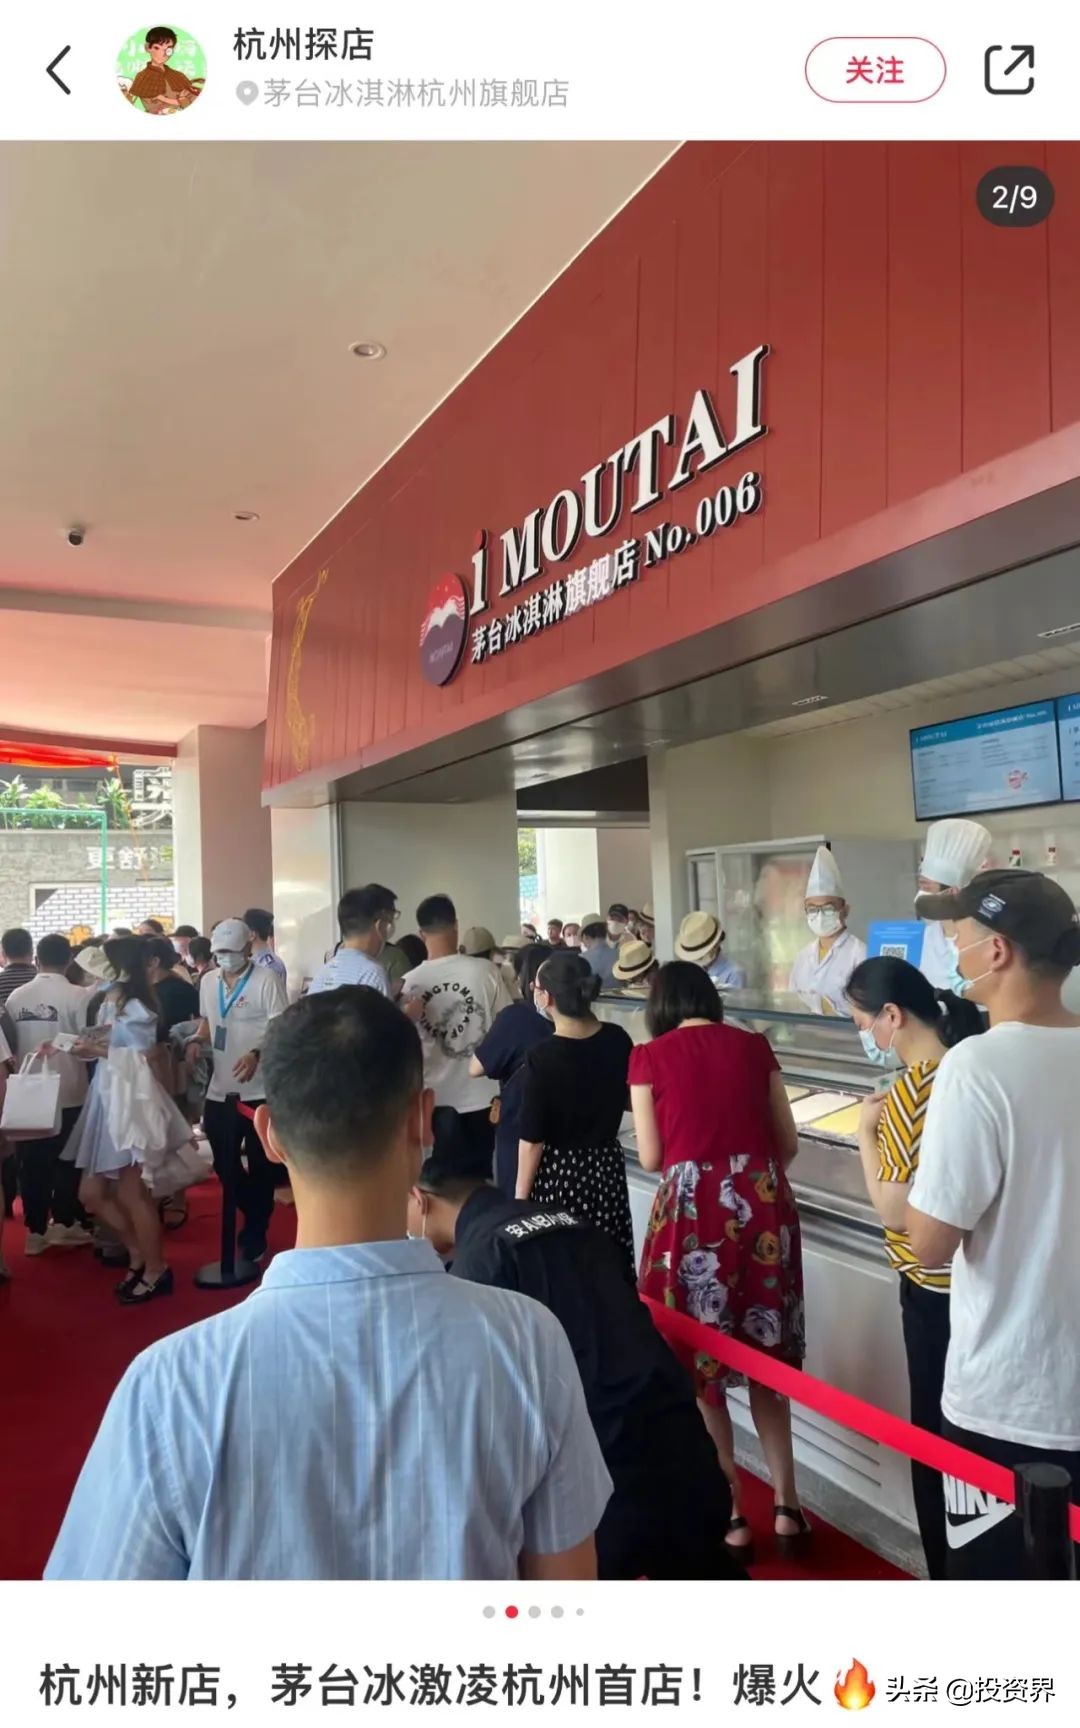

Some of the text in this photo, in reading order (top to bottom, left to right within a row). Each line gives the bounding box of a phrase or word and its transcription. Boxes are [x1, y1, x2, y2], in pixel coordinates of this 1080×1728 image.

[471, 471, 761, 663] 茅台冰淇淋旗舰店 No.006
[499, 344, 770, 598] MOUTAI
